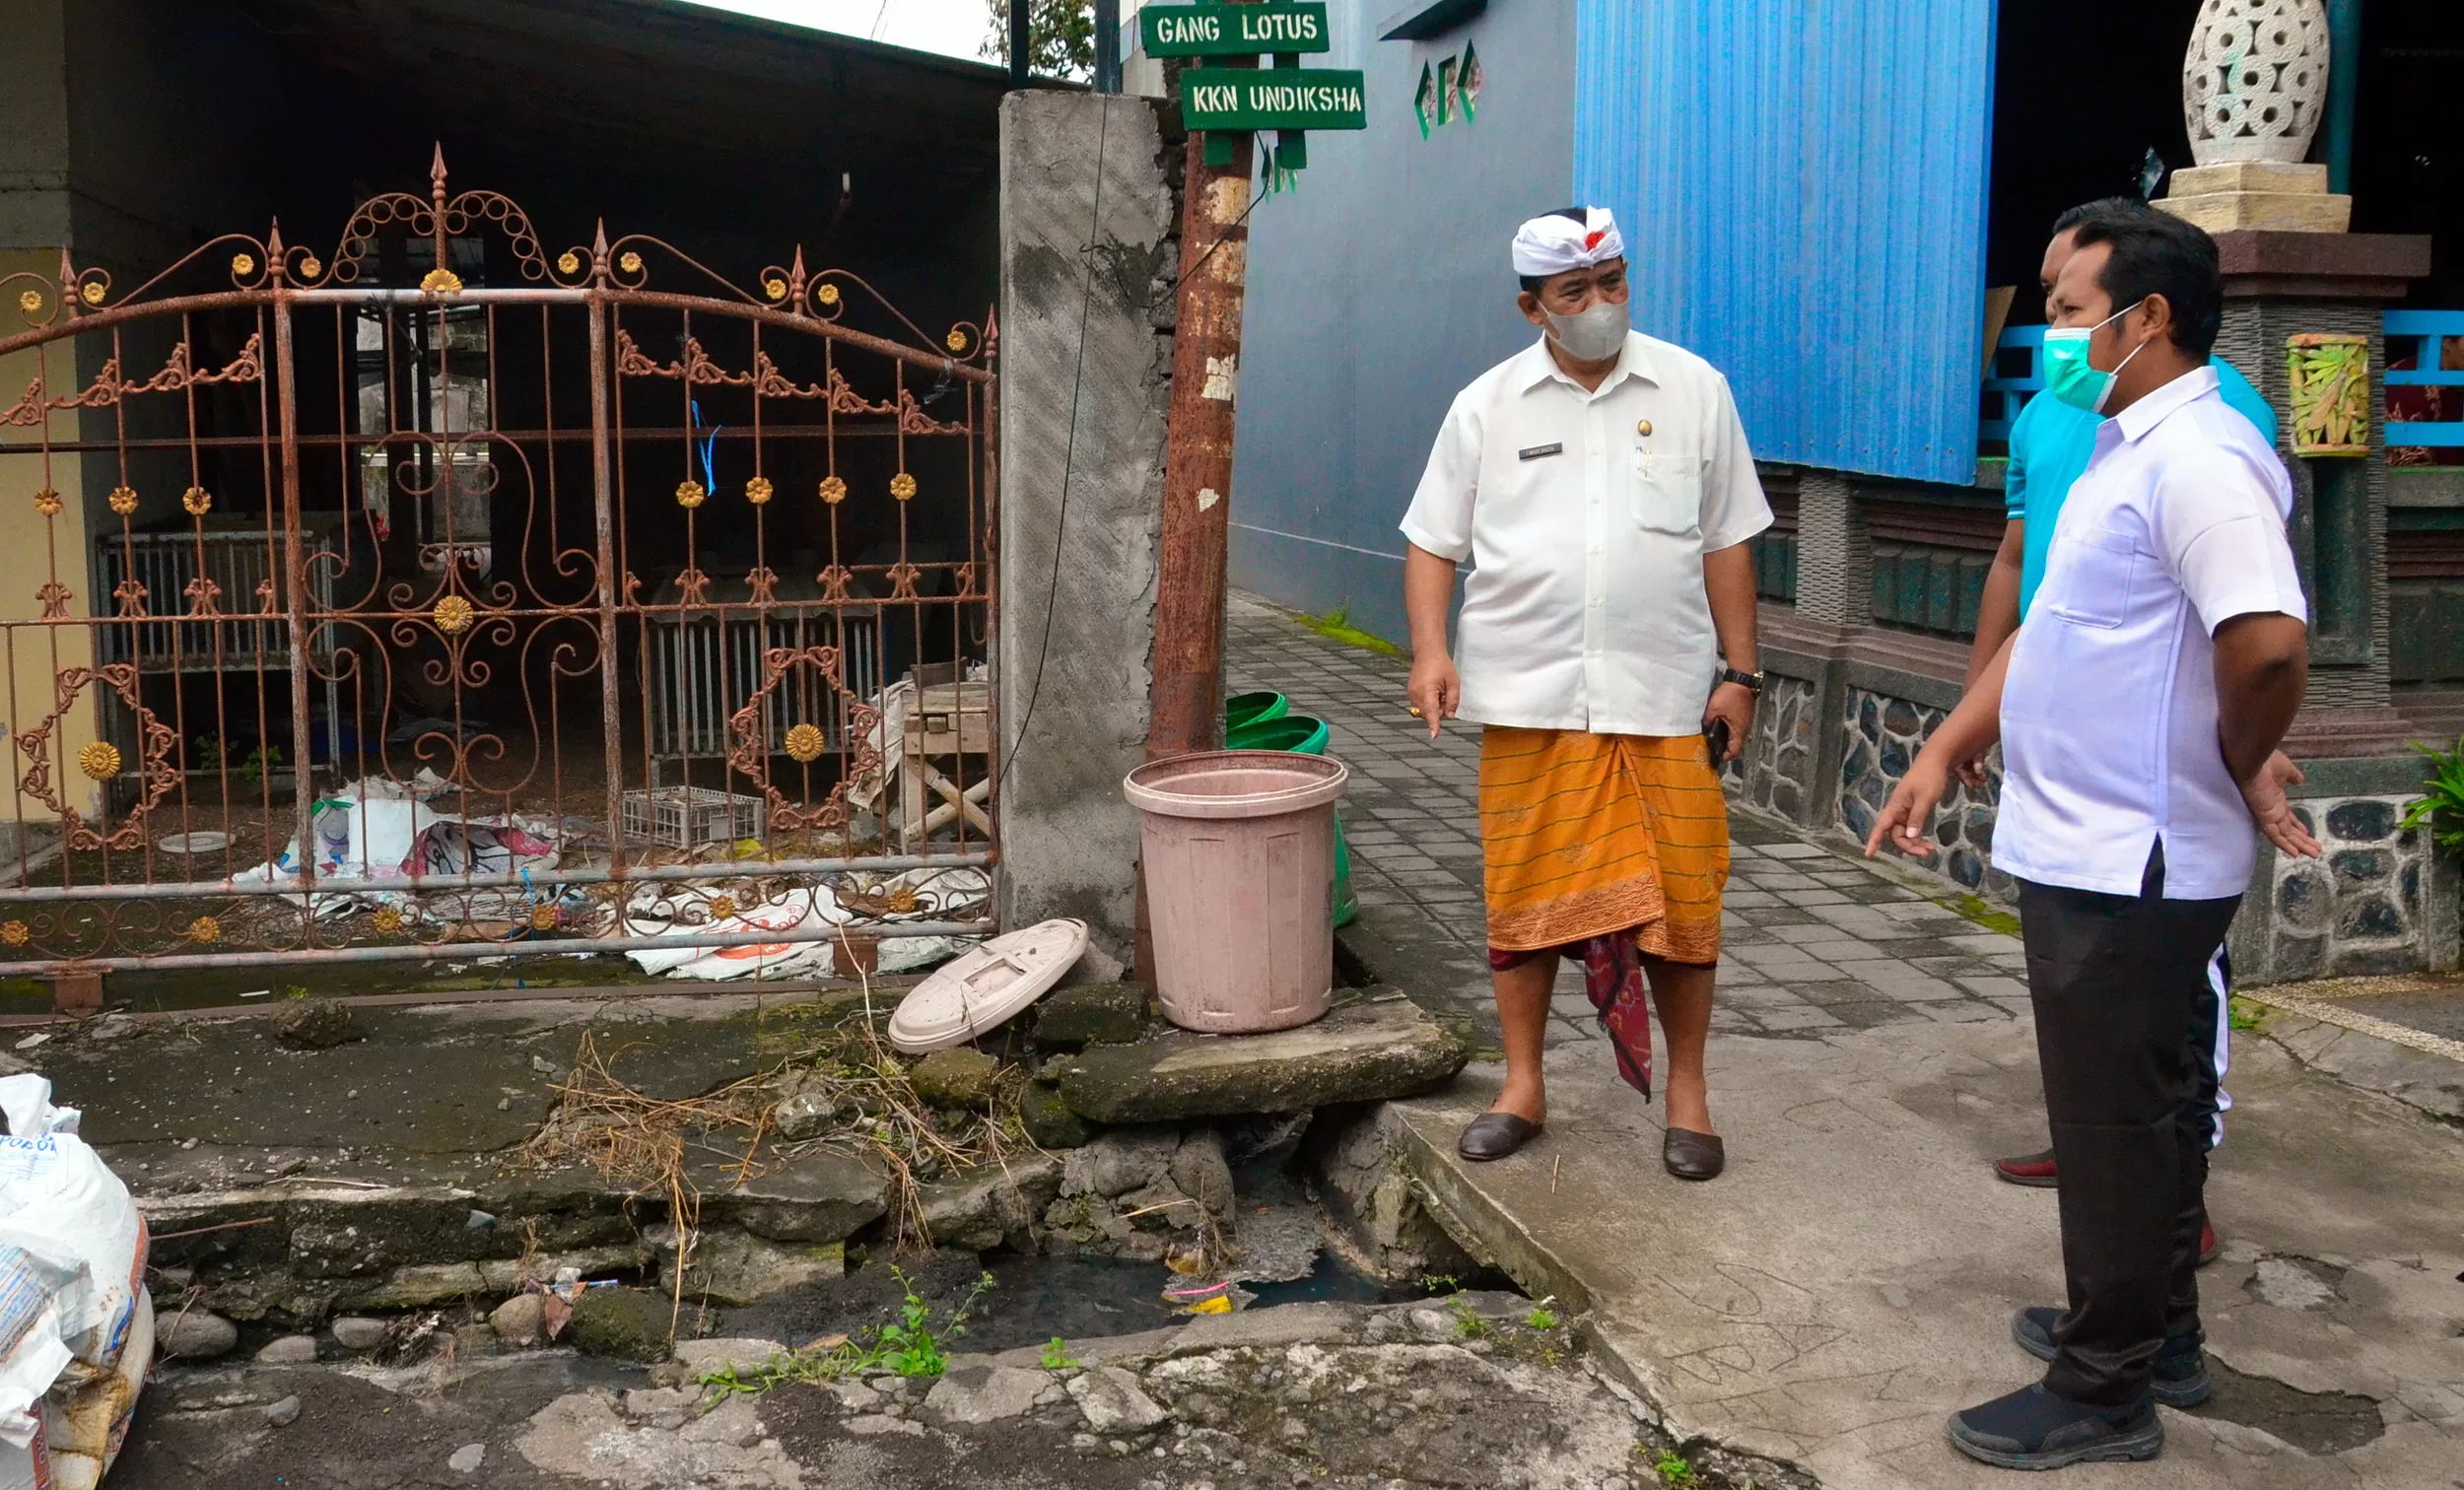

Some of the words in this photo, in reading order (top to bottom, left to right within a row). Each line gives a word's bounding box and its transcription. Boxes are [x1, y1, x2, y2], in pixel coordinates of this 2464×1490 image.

[1157, 16, 1220, 43] GANG
[1242, 14, 1318, 40] LOTUS
[1193, 86, 1238, 112] KKN
[1250, 86, 1362, 112] UNDIKSHA
